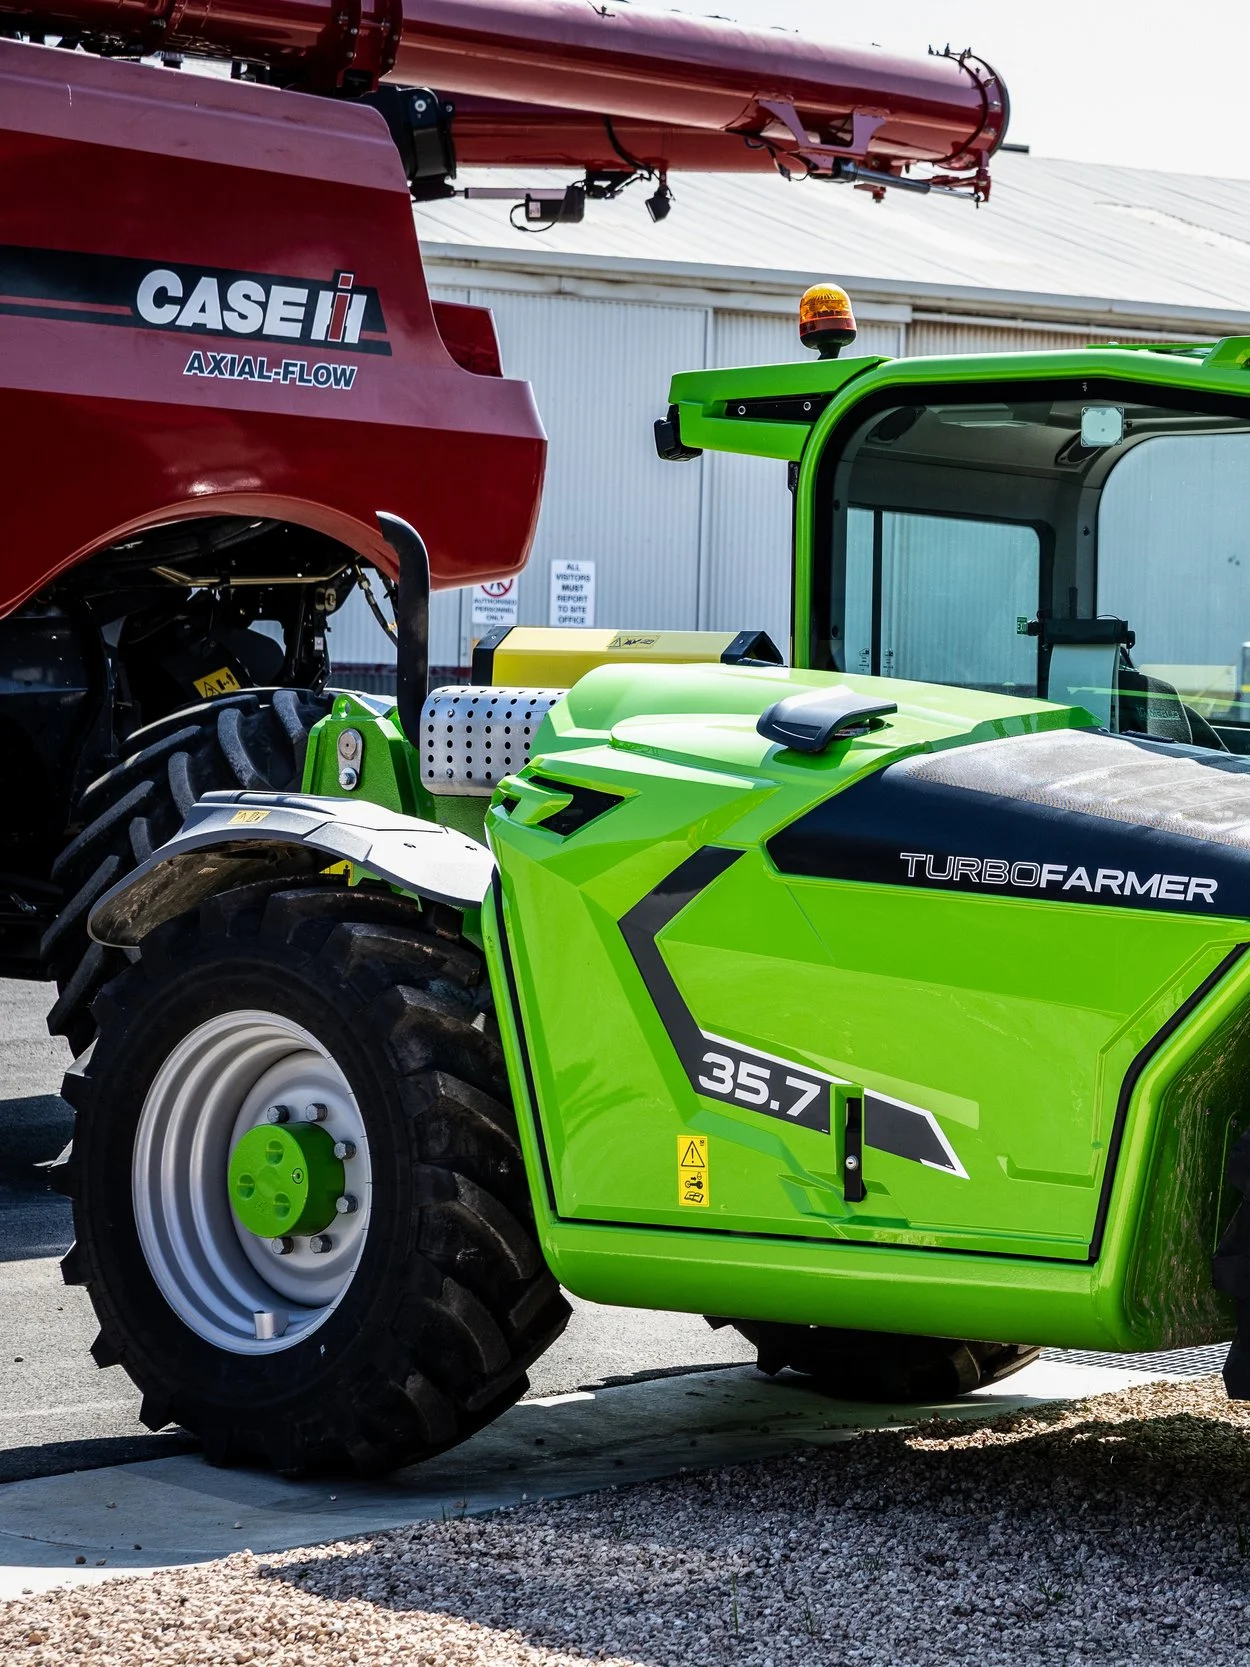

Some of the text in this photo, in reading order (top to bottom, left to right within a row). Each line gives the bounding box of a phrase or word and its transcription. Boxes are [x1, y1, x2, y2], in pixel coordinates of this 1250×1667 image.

[137, 269, 309, 338] CASE
[183, 351, 357, 389] AXIAL-FLOW
[566, 563, 580, 571] ALL
[555, 574, 591, 582] VISITORS
[561, 584, 584, 592] MUST
[557, 595, 588, 603] REPORT
[558, 616, 585, 624] OFFICE
[900, 853, 1218, 903] TURBOFARMER
[698, 1052, 821, 1117] 35.7
